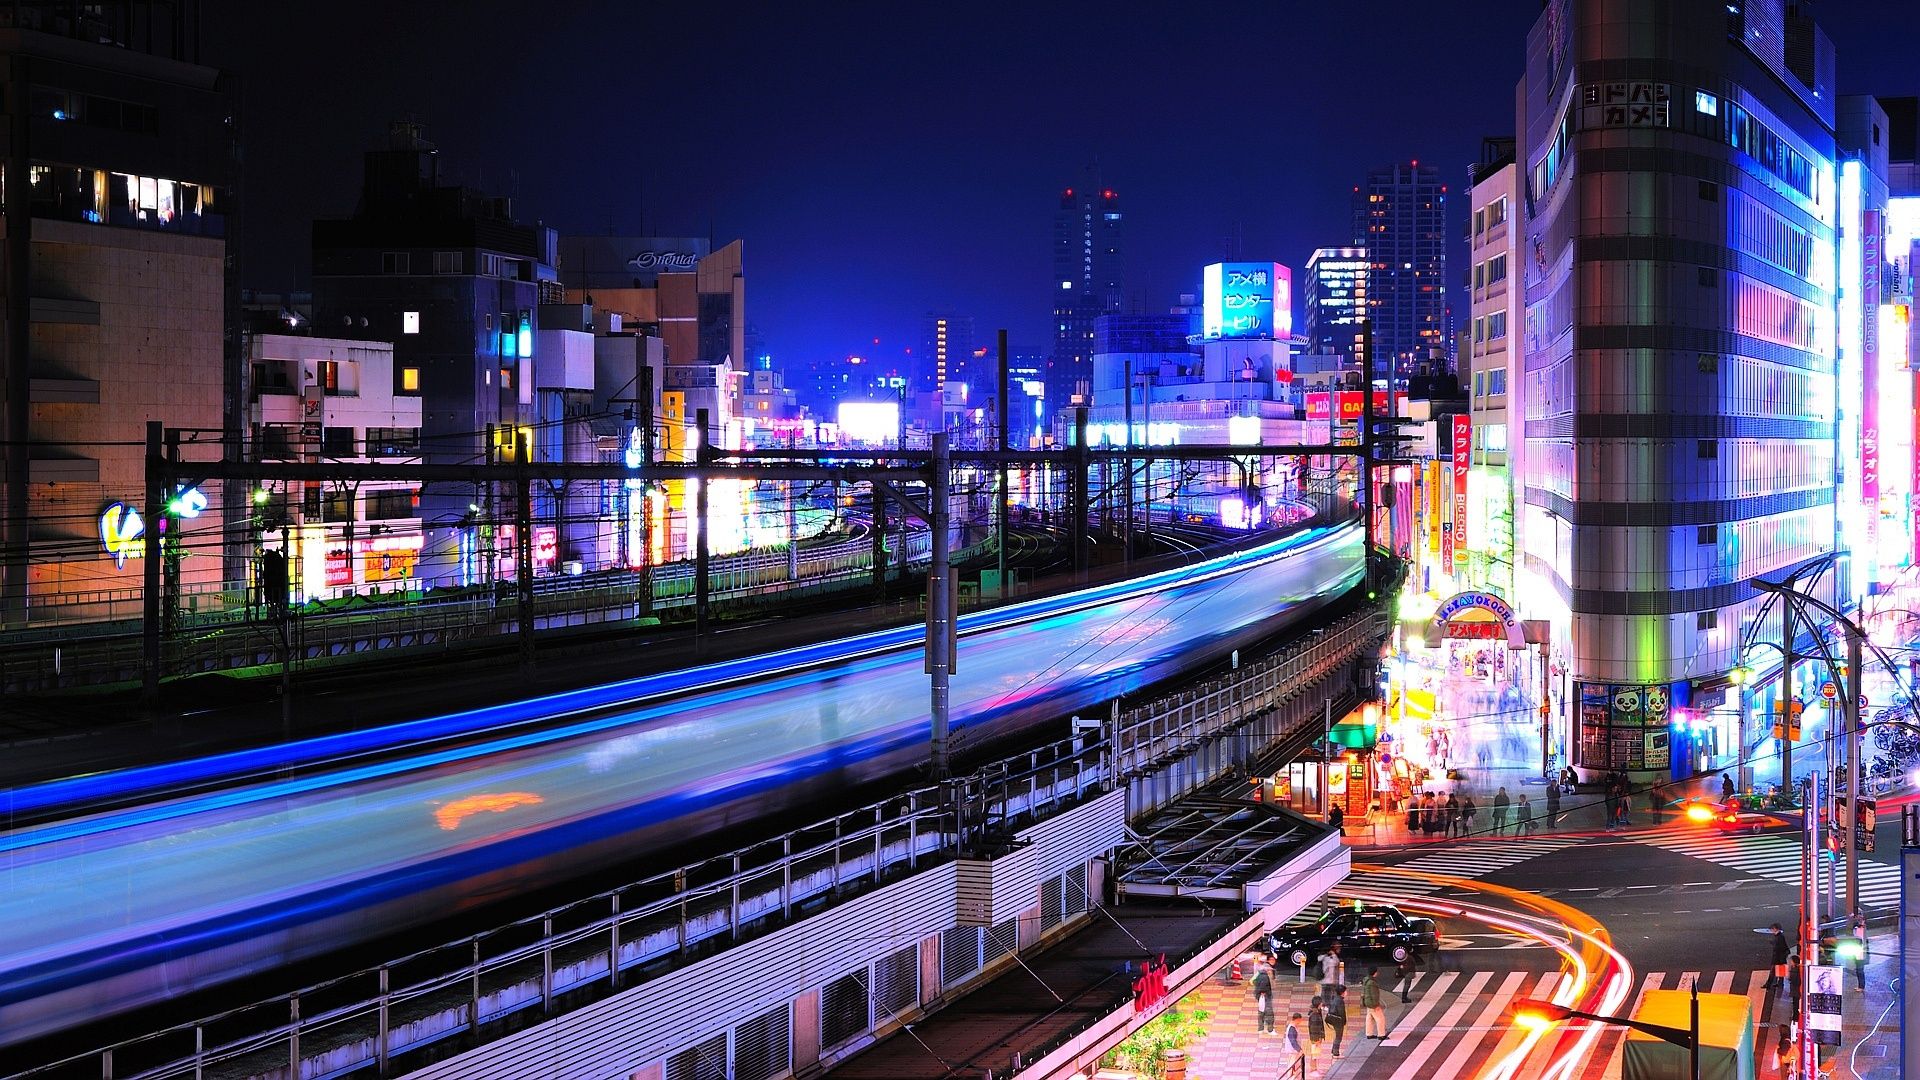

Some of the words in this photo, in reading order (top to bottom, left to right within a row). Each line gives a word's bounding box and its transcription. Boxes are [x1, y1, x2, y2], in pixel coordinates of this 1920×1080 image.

[629, 252, 697, 269] Oriental
[1865, 234, 1878, 290] カラオケ
[1228, 270, 1267, 287] アメ横
[1224, 294, 1271, 309] センター
[1233, 315, 1261, 330] ビル
[1455, 424, 1468, 476] カラオケ
[1863, 428, 1878, 484] カラオケ
